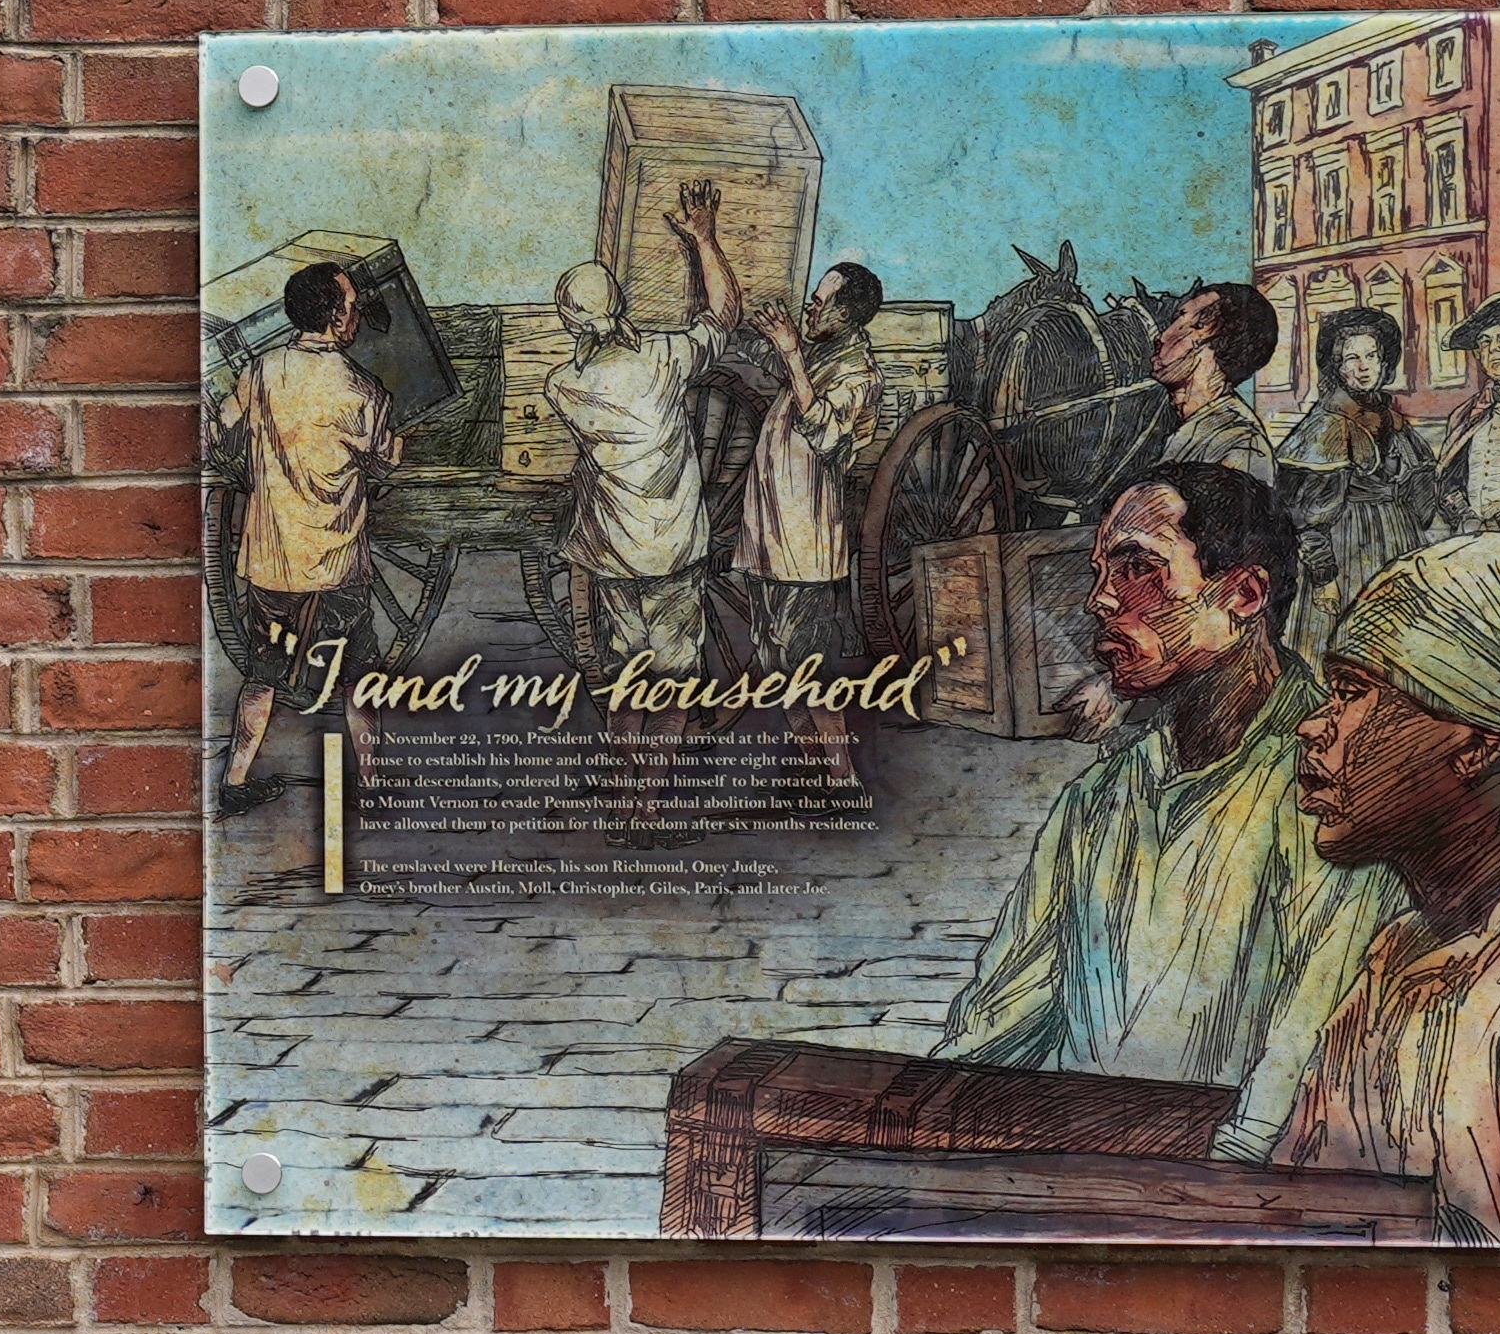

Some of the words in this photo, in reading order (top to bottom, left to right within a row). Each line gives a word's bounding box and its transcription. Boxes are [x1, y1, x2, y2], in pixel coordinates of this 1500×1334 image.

[352, 653, 483, 712] and
[480, 671, 581, 733] my
[359, 731, 381, 745] On
[384, 731, 457, 745] November
[458, 732, 482, 747] 22,
[486, 732, 523, 747] 1790,
[526, 731, 593, 745] President
[598, 731, 683, 749] Washington
[686, 731, 736, 745] arrived
[738, 733, 753, 745] at
[756, 731, 780, 745] the
[783, 731, 860, 745] President's
[359, 753, 404, 767] House
[407, 755, 423, 767] to
[425, 753, 487, 767] establish
[489, 753, 511, 767] his
[514, 753, 553, 767] home
[556, 753, 582, 767] and
[584, 753, 628, 767] office.
[631, 753, 669, 767] With
[672, 753, 700, 767] him
[702, 757, 738, 767] were
[740, 753, 777, 770] eight
[780, 753, 841, 767] enslaved
[359, 774, 411, 787] African
[414, 774, 503, 789] descendants,
[505, 774, 561, 787] ordered
[563, 774, 581, 791] by
[584, 774, 670, 791] Washington
[673, 774, 728, 787] himself
[732, 775, 747, 787] to
[750, 774, 768, 787] be
[771, 774, 823, 787] rotated
[826, 774, 861, 787] back
[359, 797, 375, 809] to
[377, 795, 426, 809] Mount
[429, 795, 483, 809] Vernon
[483, 797, 498, 809] to
[500, 795, 541, 809] evade
[544, 795, 644, 813] Pennsylvania's
[646, 795, 700, 813] gradual
[703, 795, 767, 809] abolition
[770, 795, 794, 809] law
[797, 795, 827, 809] that
[830, 795, 874, 809] would
[359, 817, 391, 831] have
[393, 817, 448, 831] allowed
[451, 817, 487, 831] them
[490, 819, 506, 831] to
[508, 817, 565, 834] petition
[568, 817, 590, 831] for
[592, 817, 627, 831] their
[629, 817, 688, 831] freedom
[691, 817, 726, 831] after
[728, 817, 750, 831] six
[752, 817, 806, 831] months
[808, 817, 880, 831] residence.
[359, 859, 389, 873] The
[391, 859, 451, 873] enslaved
[453, 863, 488, 873] were
[490, 859, 557, 875] Hercules,
[559, 859, 581, 873] his
[583, 863, 609, 873] son
[612, 859, 689, 875] Richmond,
[691, 859, 730, 877] Oney
[731, 859, 780, 877] Judge,
[359, 881, 406, 898] Oney's
[408, 881, 463, 895] brother
[464, 881, 515, 897] Austin,
[517, 881, 556, 897] Moll,
[559, 881, 646, 898] Christopher,
[649, 881, 691, 897] Giles,
[694, 881, 734, 897] Paris,
[737, 881, 763, 895] and
[766, 881, 800, 895] later
[802, 881, 831, 895] Joe.
